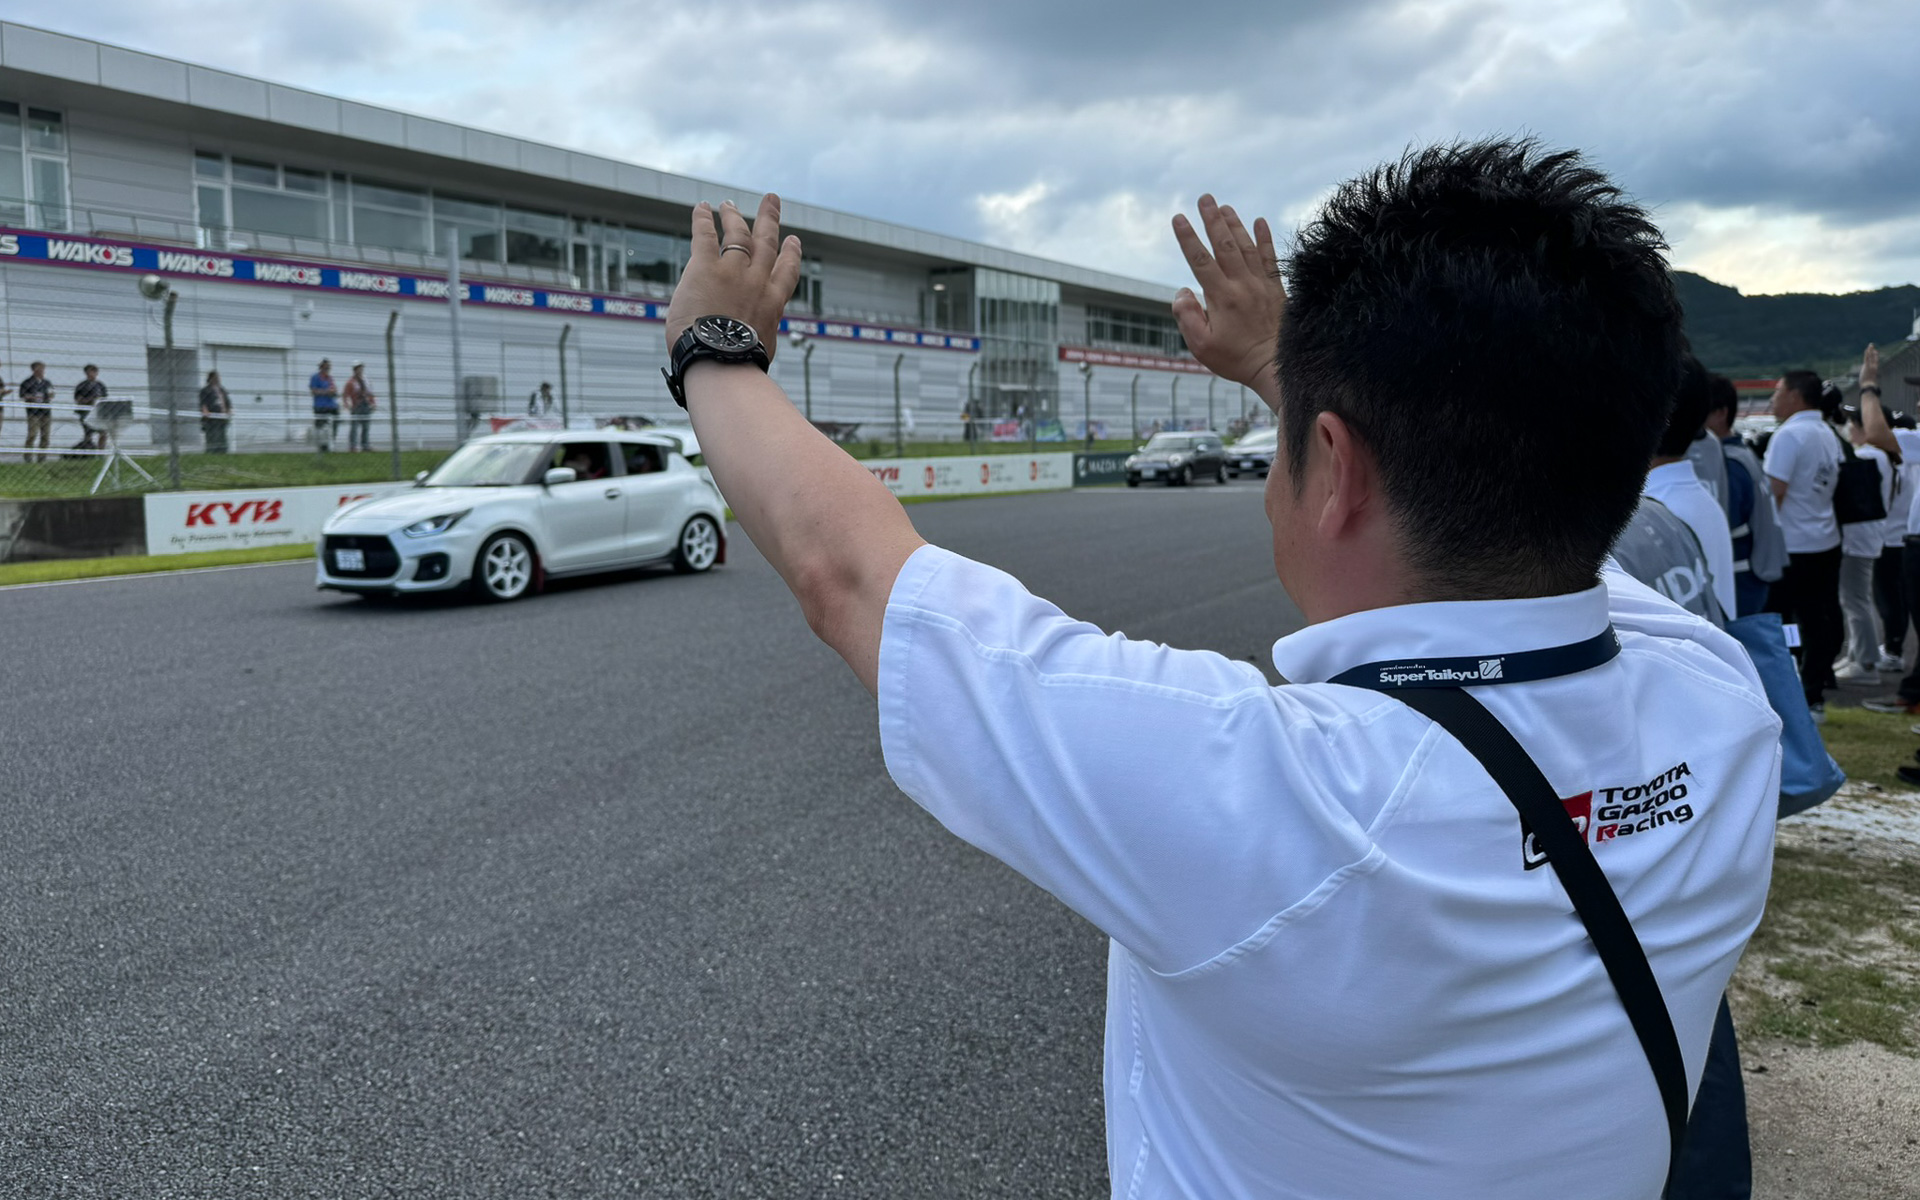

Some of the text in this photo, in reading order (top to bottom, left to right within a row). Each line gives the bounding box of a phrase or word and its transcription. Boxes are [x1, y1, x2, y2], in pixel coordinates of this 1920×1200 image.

[185, 499, 282, 527] KYB
[1599, 762, 1691, 804] TOYOTA
[1597, 784, 1688, 822] GAZOO
[1596, 804, 1694, 842] Racing
